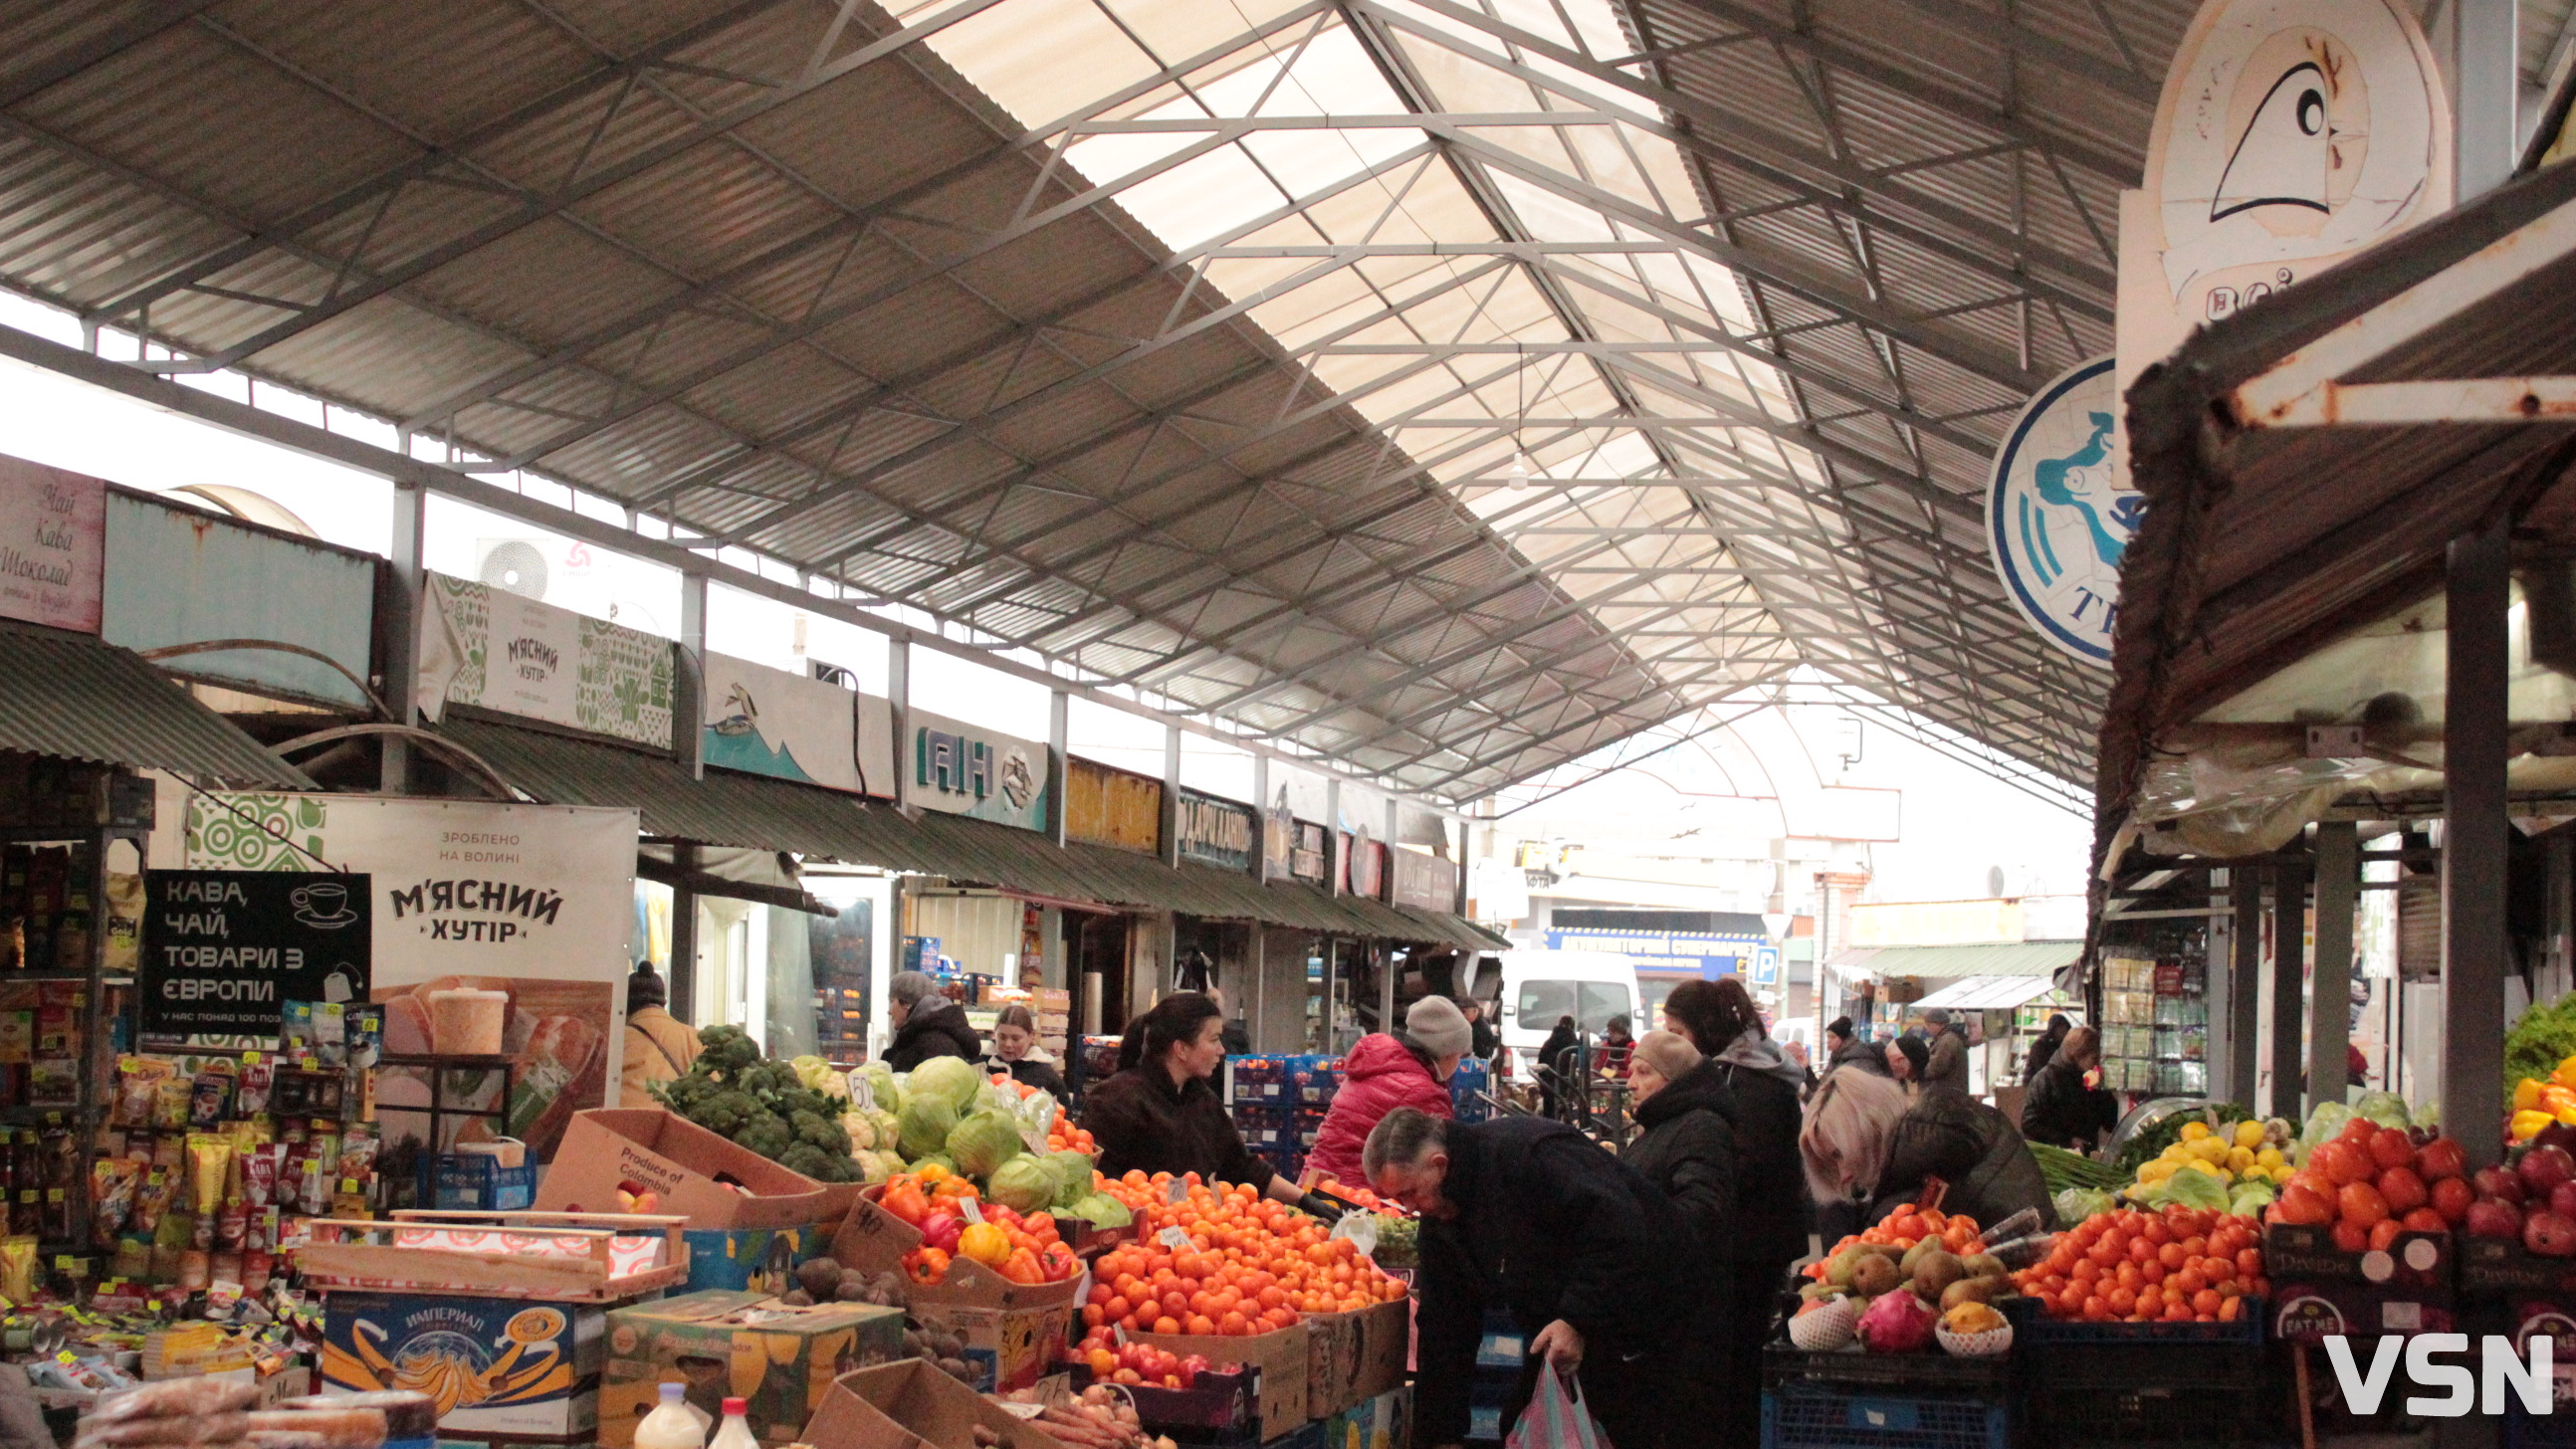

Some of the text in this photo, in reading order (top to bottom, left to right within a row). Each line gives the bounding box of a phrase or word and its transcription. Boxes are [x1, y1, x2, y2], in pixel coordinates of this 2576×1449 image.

[36, 518, 73, 551] Кава
[1, 546, 74, 586] Шоколад
[520, 664, 545, 683] ХУТІР
[442, 832, 520, 846] ЗРОБЛЕНО
[439, 851, 520, 864] НА ВОЛИНІ
[167, 881, 248, 907] КАВА,
[389, 878, 564, 926] М'ЯСНИЙ
[165, 907, 230, 939] ЧАЙ,
[431, 919, 518, 942] ХУТІР
[164, 945, 305, 969] ТОВАРИ З
[1758, 951, 1775, 979] P
[162, 978, 275, 1002] ЄВРОПИ
[161, 1012, 170, 1021] У
[172, 1012, 194, 1021] НАС
[198, 1013, 235, 1022] ПОНАД
[260, 1014, 282, 1023] ПОЗ
[853, 1077, 871, 1110] 50
[621, 1146, 685, 1184] Produce of
[620, 1163, 672, 1195] Colombia
[405, 1307, 486, 1332] ИМПЕРИАЛ
